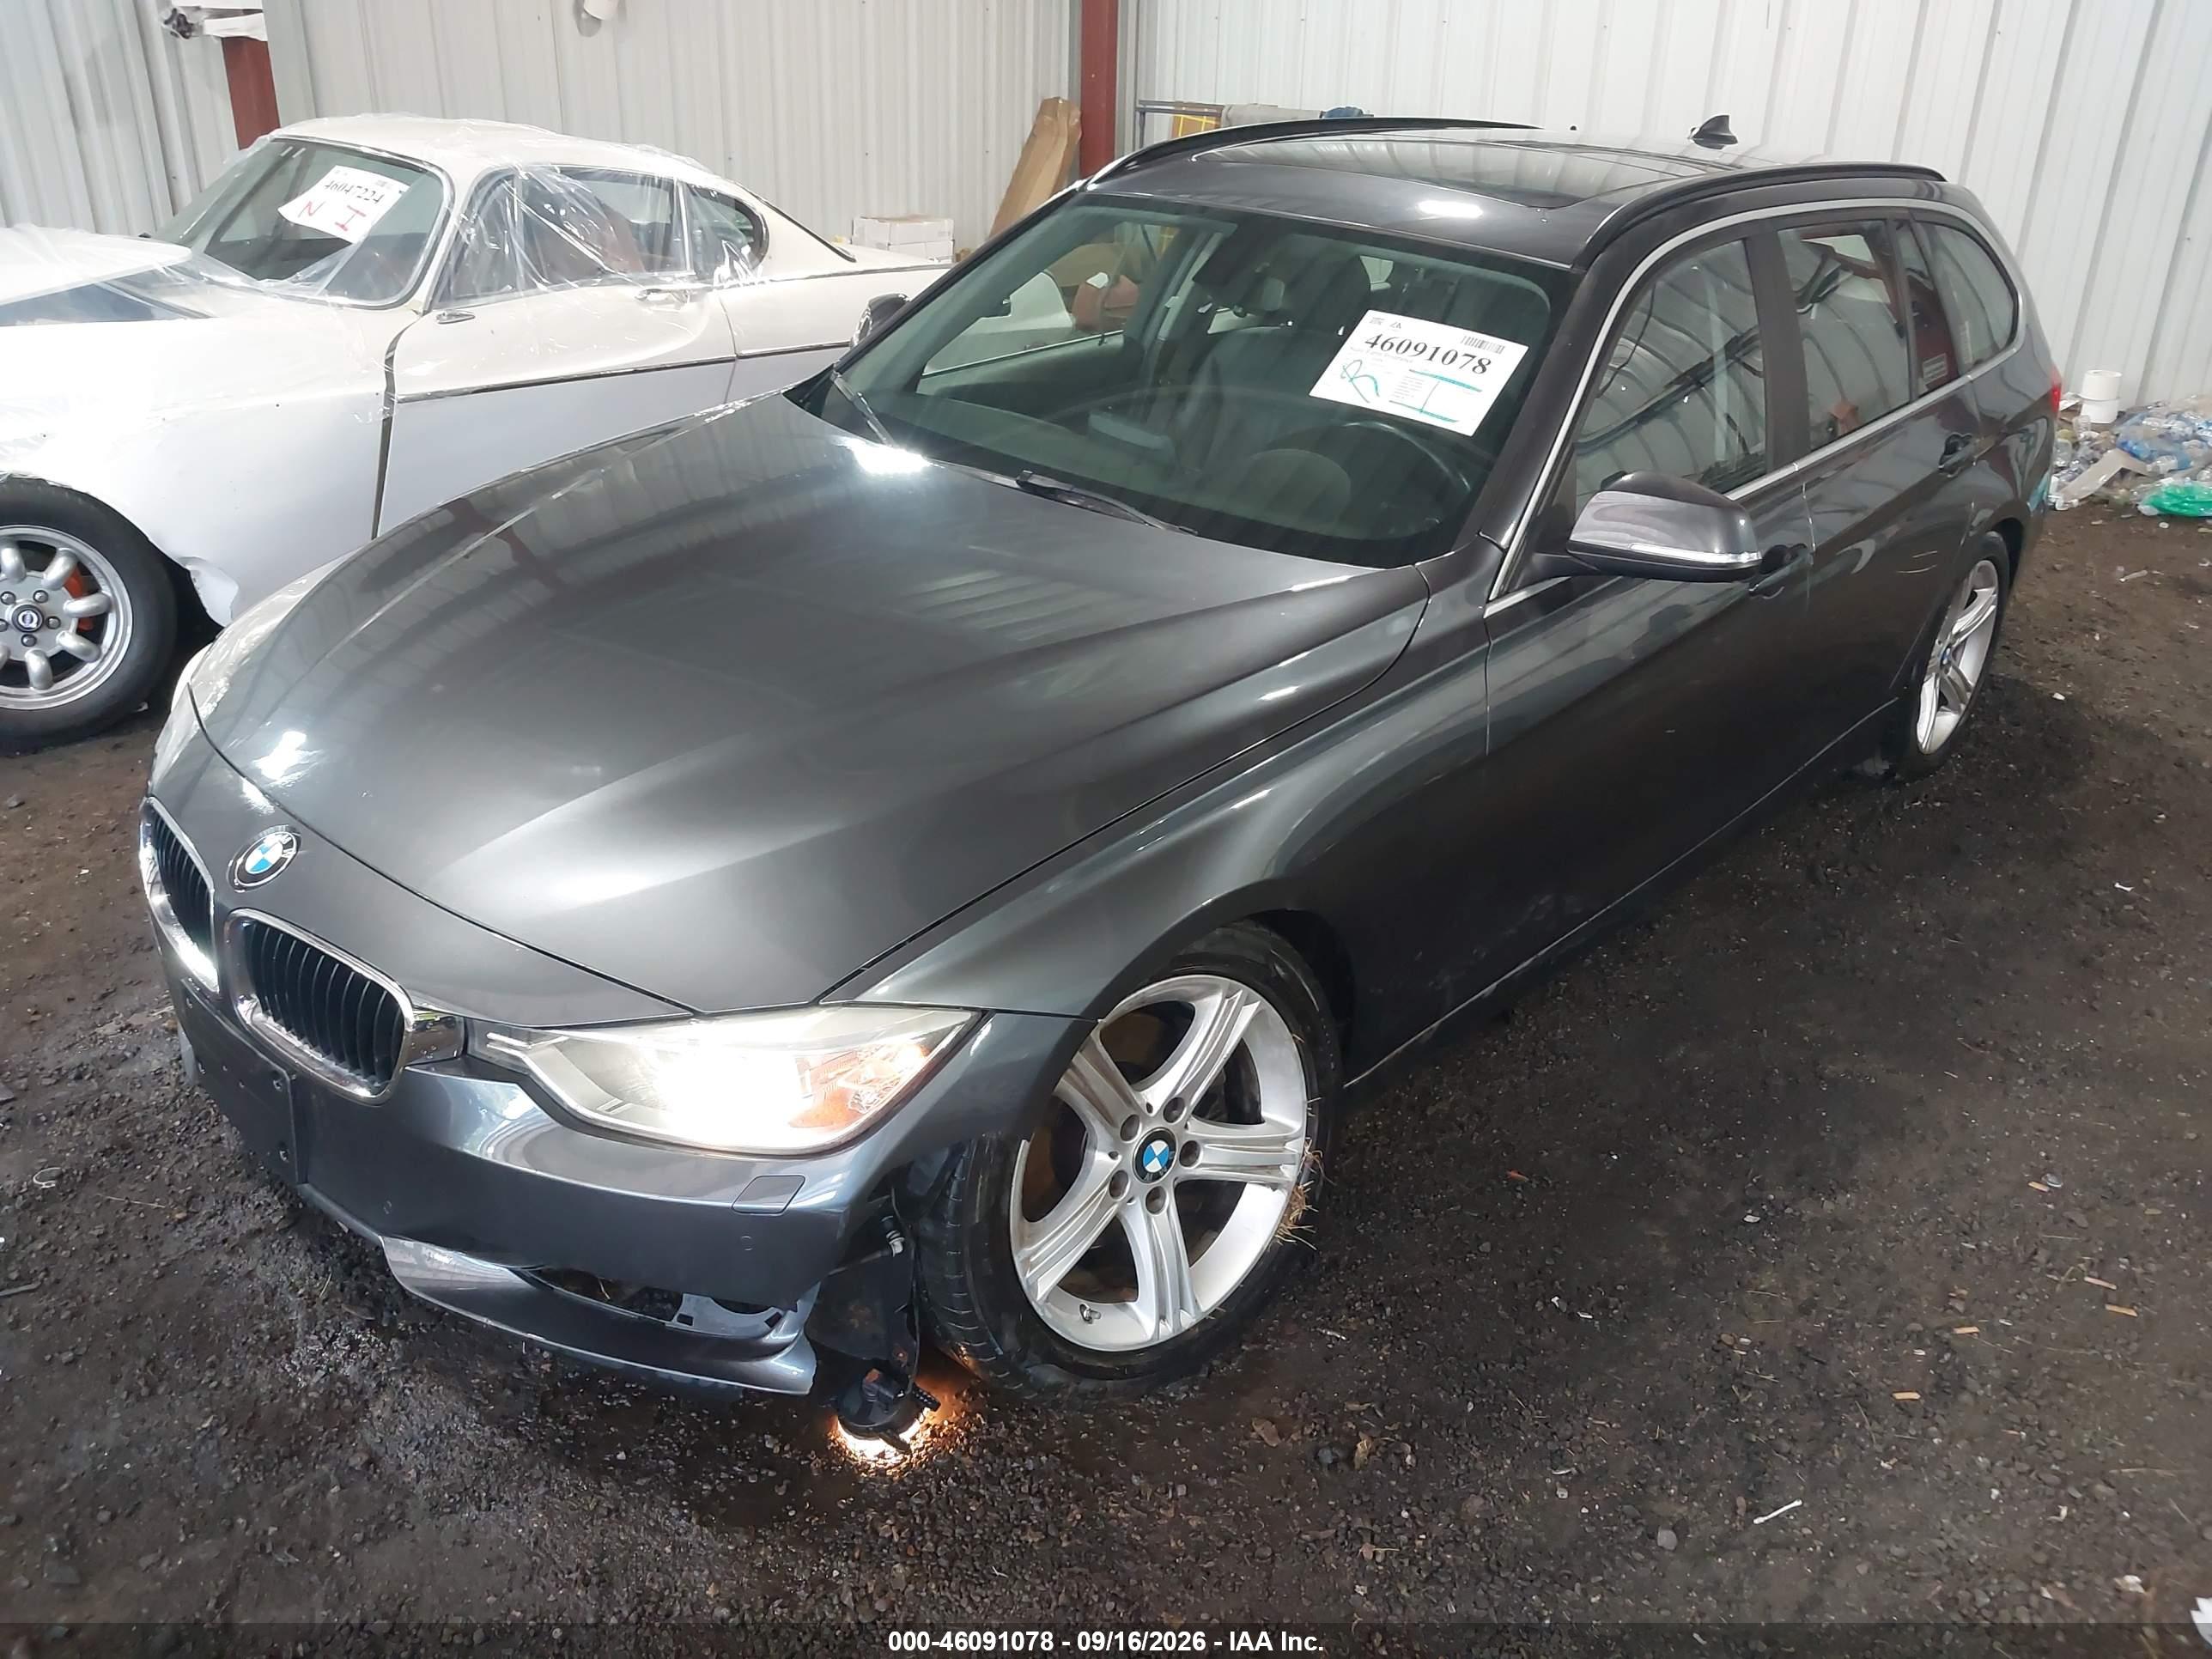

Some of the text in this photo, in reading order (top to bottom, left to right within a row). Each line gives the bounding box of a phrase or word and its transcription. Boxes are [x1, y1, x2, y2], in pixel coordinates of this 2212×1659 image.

[298, 201, 367, 231] N I
[1364, 333, 1492, 374] 46091078
